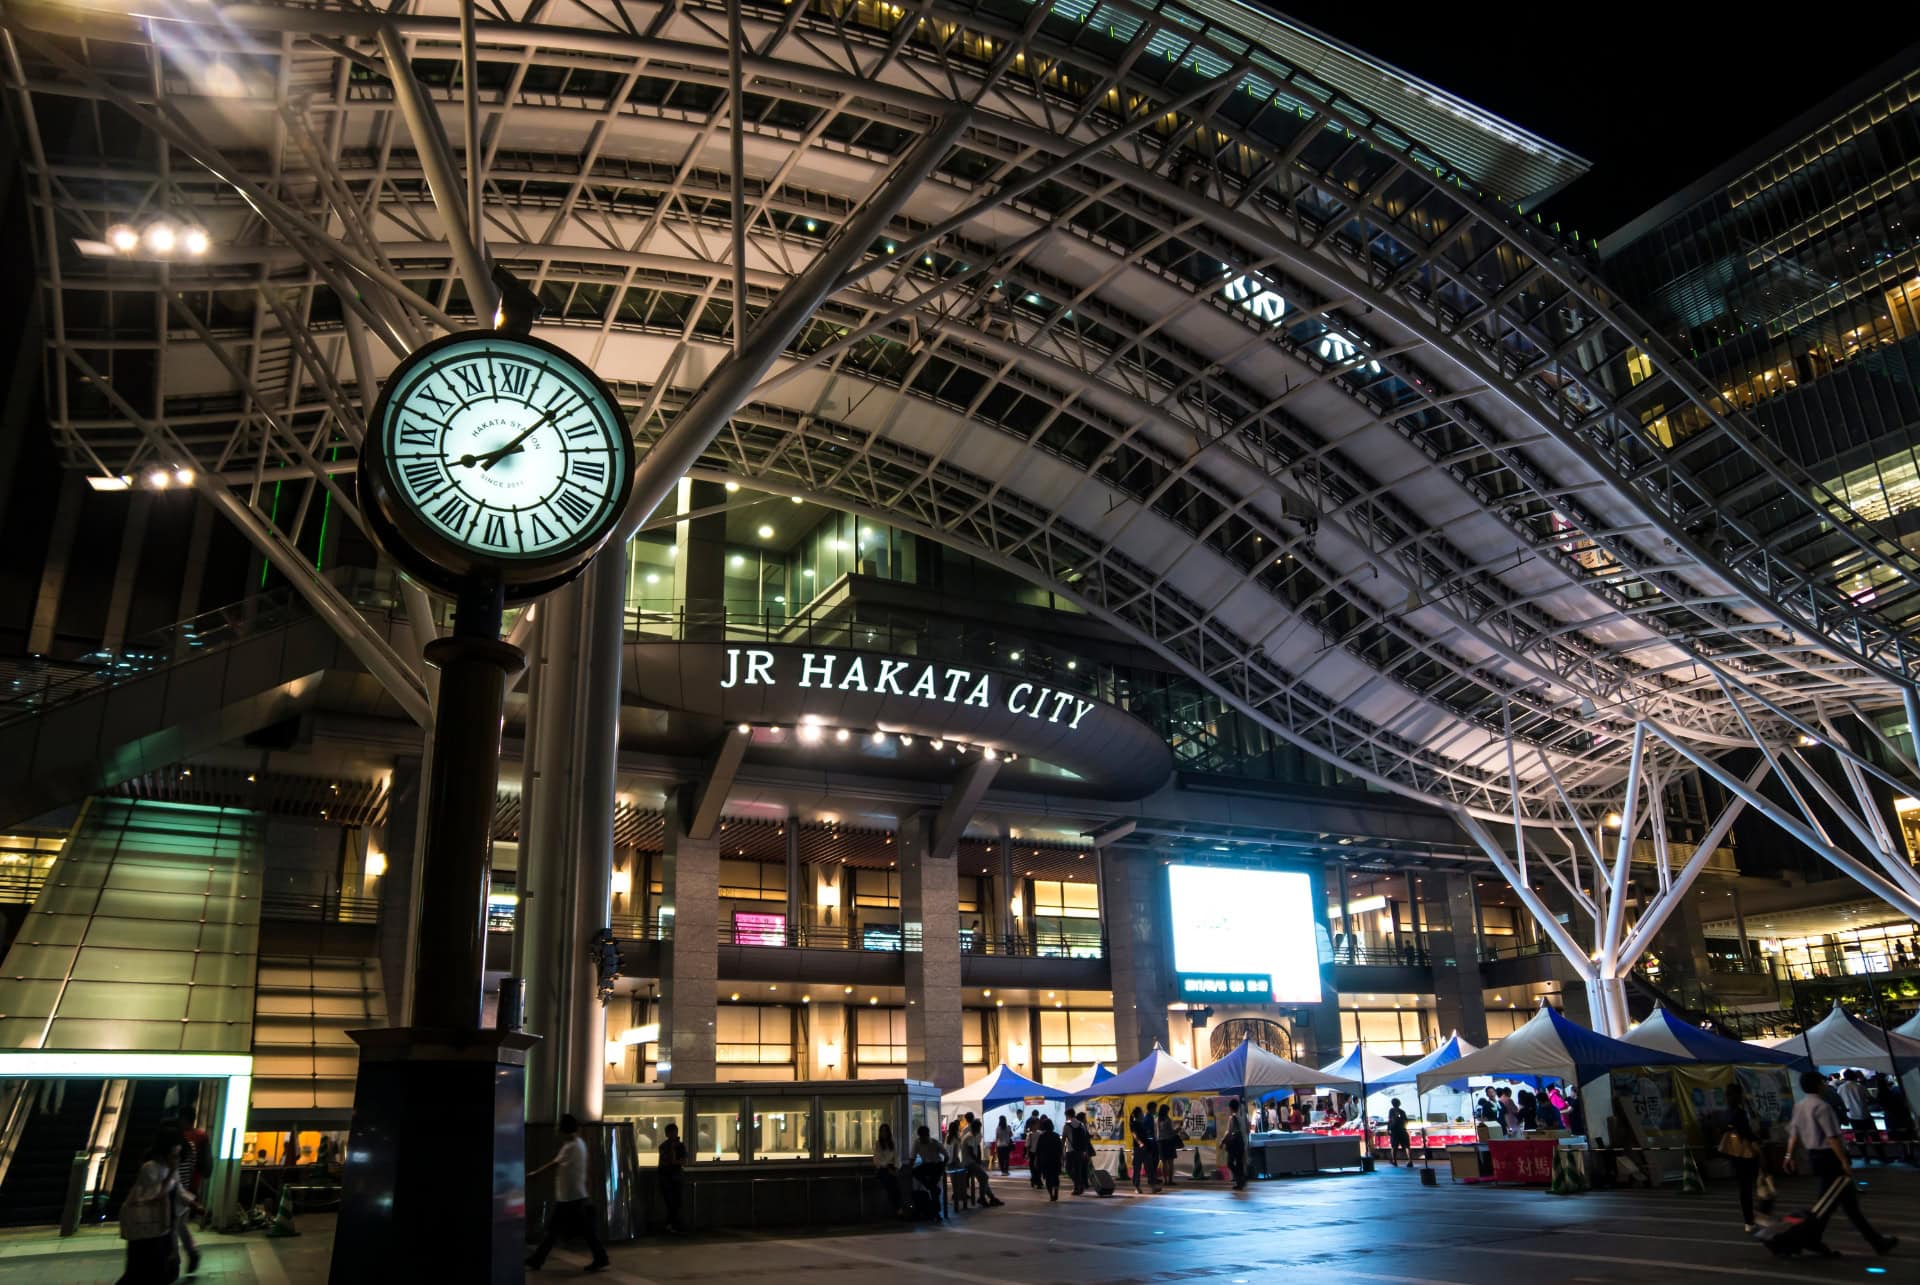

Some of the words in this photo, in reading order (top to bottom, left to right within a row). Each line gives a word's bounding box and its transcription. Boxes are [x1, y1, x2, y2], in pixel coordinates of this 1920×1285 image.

[453, 364, 485, 397] XI
[498, 363, 531, 396] XII
[416, 383, 455, 417] X
[400, 419, 437, 448] IX
[471, 418, 506, 438] HAKATA
[509, 420, 542, 450] STAION
[564, 419, 598, 442] II
[402, 461, 445, 498] VIII
[571, 458, 605, 484] III
[432, 493, 472, 535] VII
[555, 489, 594, 525] IIII
[482, 513, 509, 548] VI
[530, 512, 559, 547] V
[719, 648, 776, 689] JR
[798, 652, 990, 709] HAKATA
[1007, 682, 1095, 730] CITY
